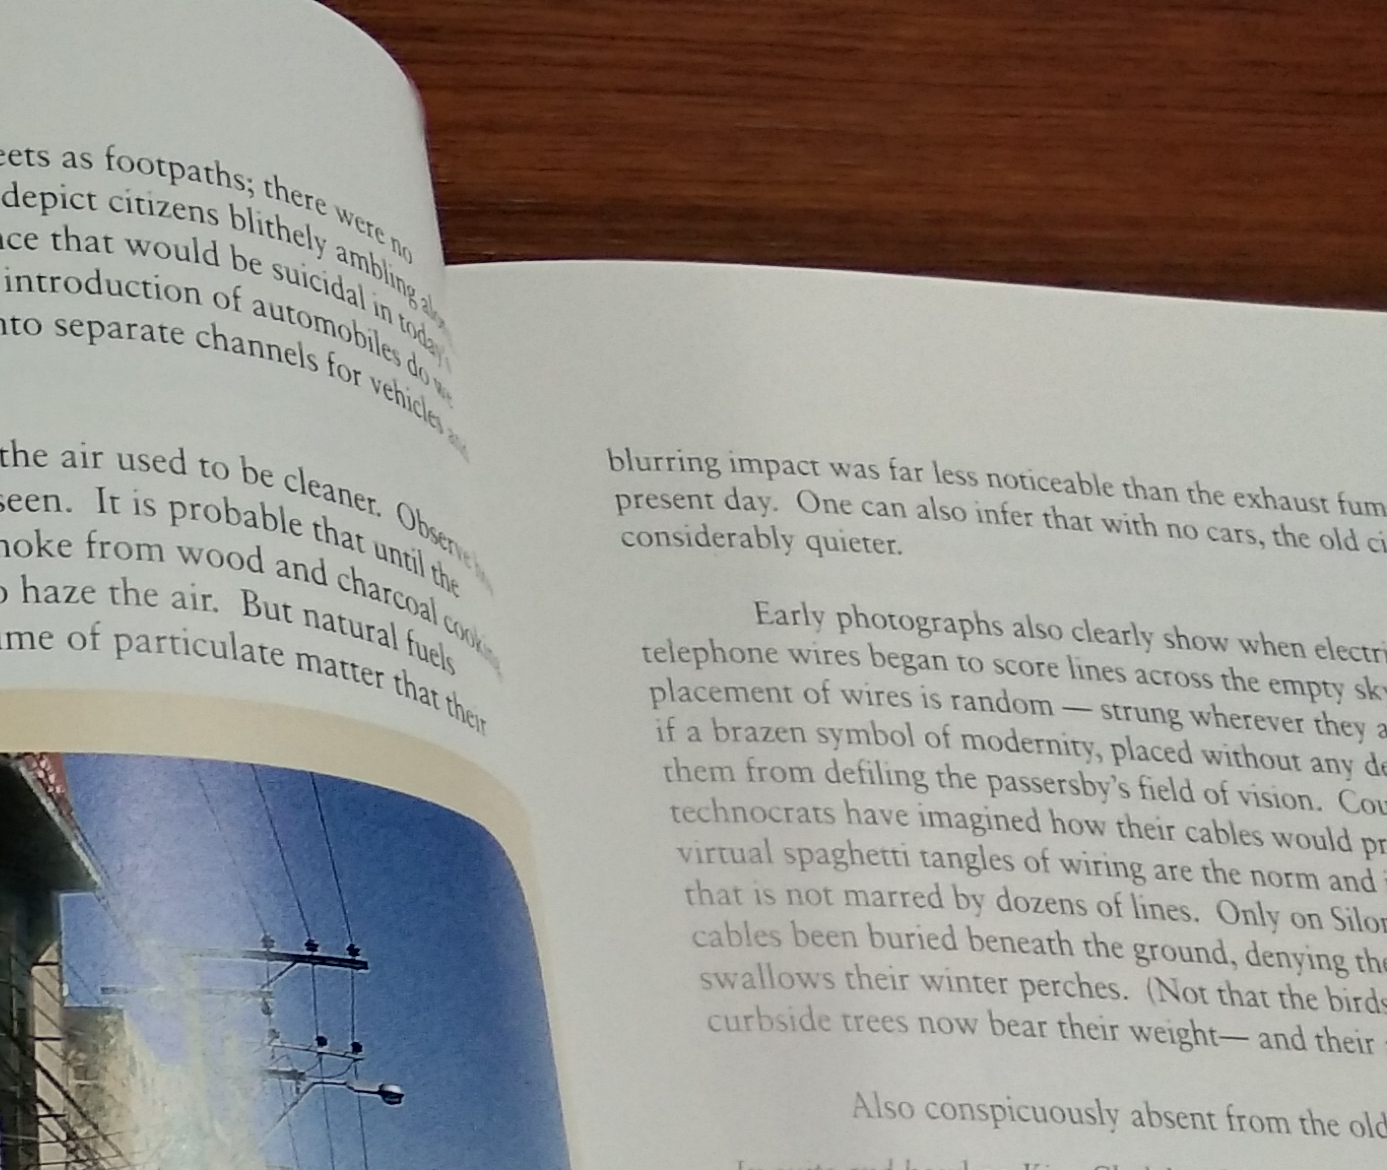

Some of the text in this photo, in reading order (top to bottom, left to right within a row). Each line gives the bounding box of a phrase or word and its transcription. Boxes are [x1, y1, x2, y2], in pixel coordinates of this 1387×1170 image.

[61, 149, 94, 171] as
[104, 142, 255, 200] footpaths;
[263, 173, 328, 217] there
[334, 205, 386, 246] were
[390, 235, 413, 266] no
[54, 317, 185, 347] separate
[195, 321, 319, 374] channels
[327, 349, 362, 388] for
[369, 375, 444, 435] vehicles
[86, 528, 165, 564] from
[176, 543, 265, 575] wood
[275, 556, 329, 587] and
[337, 564, 438, 627] charcoal
[66, 619, 101, 652] of
[113, 629, 285, 668] particulate
[295, 651, 385, 691] matter
[392, 667, 441, 712] that
[445, 690, 487, 734] their
[753, 599, 826, 635] Early
[835, 602, 1005, 643] photographs
[1012, 612, 1064, 642] also
[1070, 617, 1155, 655] clearly
[1162, 623, 1230, 654] show
[1237, 629, 1308, 660] when
[662, 755, 736, 784] them
[745, 755, 816, 785] from
[824, 757, 930, 796] defiling
[934, 761, 978, 791] the
[1137, 773, 1196, 805] field
[1203, 778, 1230, 807] of
[1236, 782, 1323, 813] vision.
[852, 1090, 1387, 1141] Also conspicuously absent from the old
